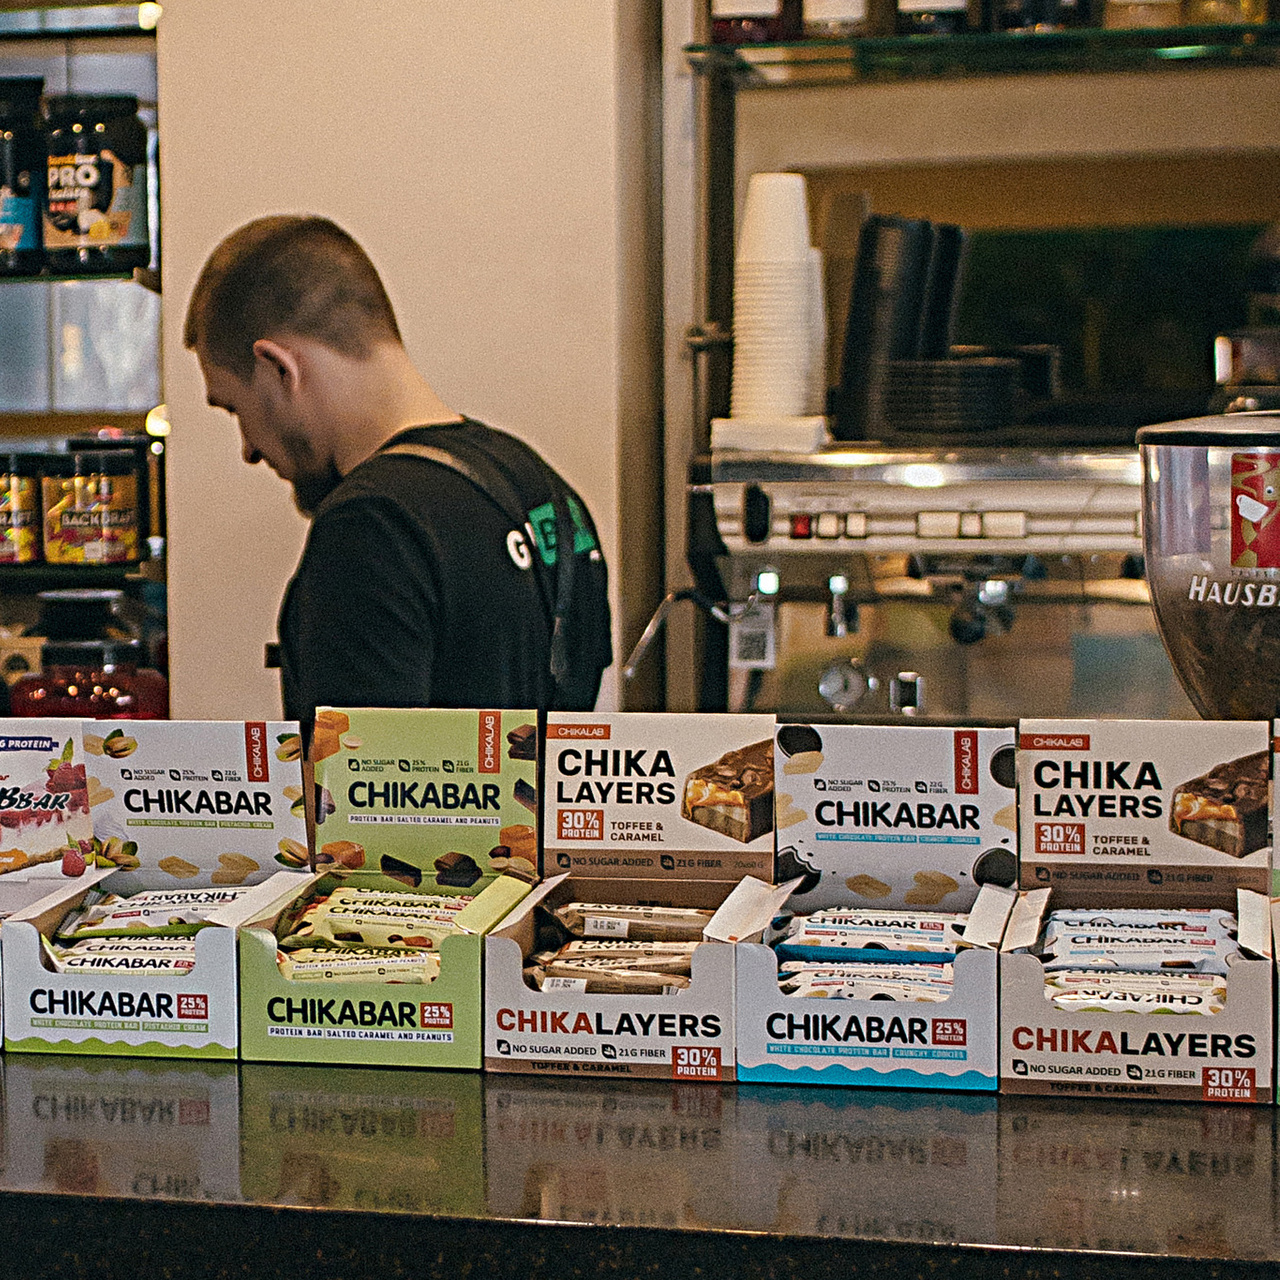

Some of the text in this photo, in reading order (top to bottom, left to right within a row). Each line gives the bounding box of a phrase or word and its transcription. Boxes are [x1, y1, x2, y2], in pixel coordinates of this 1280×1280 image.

[48, 165, 99, 188] PRO
[1188, 575, 1280, 606] HAUSB
[557, 727, 605, 737] CHIKALAB
[8, 739, 51, 750] PROTEIN
[484, 715, 495, 769] CHIKALAB
[1032, 738, 1084, 748] CHIKALAB
[251, 726, 264, 778] CHIKALAB
[557, 749, 676, 777] CHIKA
[960, 737, 971, 790] CHIKALAB
[1033, 760, 1163, 791] CHIKA
[348, 780, 501, 810] CHIKABAR
[556, 781, 676, 805] LAYERS
[123, 789, 273, 816] CHIKABAR
[1033, 793, 1163, 819] LAYERS
[562, 811, 600, 829] 30%
[815, 800, 981, 830] CHIKABAR
[610, 821, 664, 831] TOFFEE &
[561, 829, 600, 838] PROTEIN
[610, 832, 665, 842] CARAMEL
[1039, 824, 1080, 842] 30%
[1092, 835, 1150, 845] TOFFEE &
[1039, 843, 1081, 852] PROTEIN
[1092, 846, 1151, 857] CARAMEL
[572, 857, 654, 867] NO SUGAR ADDED
[806, 916, 916, 929] CHIKABAR
[66, 956, 172, 969] CHIKABAR
[29, 988, 174, 1018] CHIKABAR
[180, 997, 206, 1008] 25%
[267, 996, 417, 1028] CHIKABAR
[423, 1006, 451, 1018] 25%
[496, 1007, 722, 1038] CHIKALAYERS
[766, 1012, 928, 1044] CHIKABAR
[935, 1021, 964, 1034] 25%
[269, 1027, 453, 1041] PROTEIN BAR SALTED CARAMEL AND PEANUTS
[1011, 1026, 1257, 1058] CHIKALAYERS
[512, 1045, 598, 1056] NO SUGAR ADDED
[618, 1048, 666, 1058] 21G FIBER
[676, 1048, 718, 1066] 30%
[769, 1045, 791, 1053] WHITE
[794, 1046, 836, 1055] CHOCOLATE
[838, 1047, 871, 1056] PROTEIN
[872, 1048, 889, 1057] BAR
[894, 1049, 928, 1058] CRUNCHY
[676, 1066, 718, 1077] PROTEIN
[1029, 1064, 1122, 1077] NO SUGAR ADDED
[1144, 1068, 1196, 1080] 21G FIBER
[1206, 1069, 1251, 1088] 30%
[1207, 1087, 1251, 1098] PROTEIN
